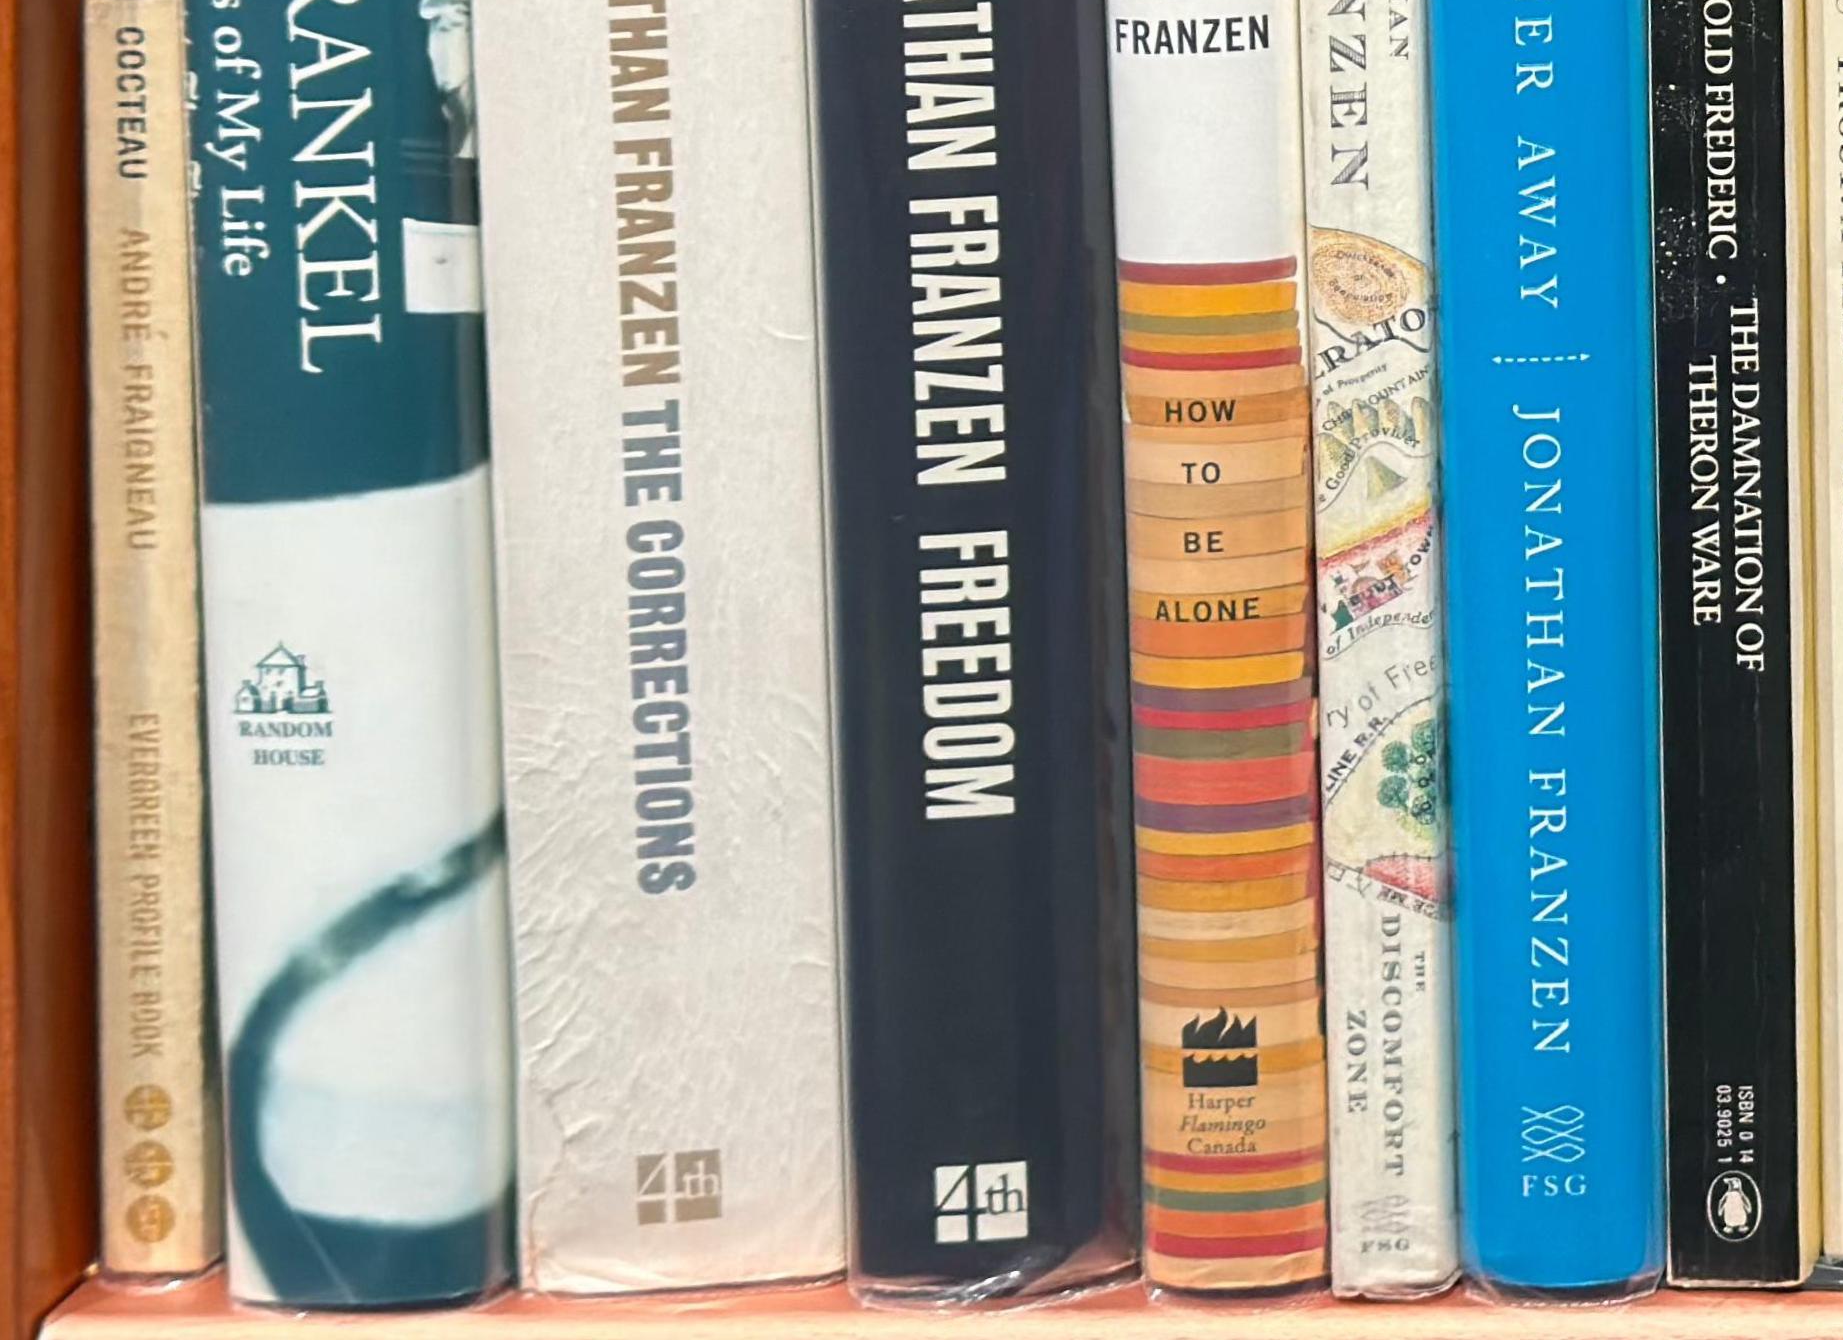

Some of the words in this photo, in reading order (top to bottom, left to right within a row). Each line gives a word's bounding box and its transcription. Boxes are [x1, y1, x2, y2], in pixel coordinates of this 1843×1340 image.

[210, 25, 261, 79] of
[1115, 14, 1269, 55] FRANZEN
[116, 26, 146, 181] COCTEAU
[205, 87, 262, 171] My
[1706, 82, 1738, 261] FREDERIC
[220, 185, 269, 276] Life
[613, 138, 681, 387] FRANZEN
[1517, 134, 1559, 310] AWAY
[119, 229, 167, 342] ANDRÉ
[909, 195, 1006, 484] FRANZEN
[1315, 308, 1426, 380] RATO
[1730, 297, 1759, 374] THE
[1164, 400, 1236, 423] HOW
[1688, 355, 1720, 512] THERON
[123, 362, 156, 551] FRAIGNEAU
[621, 400, 683, 507] THE
[1181, 462, 1221, 484] TO
[1731, 382, 1764, 615] DAMNATION
[1184, 531, 1224, 553] BE
[1512, 403, 1566, 737] JONATHAN
[1692, 519, 1722, 626] WARE
[1155, 597, 1261, 622] ALONE
[1736, 624, 1765, 672] OF
[625, 520, 696, 895] CORRECTIONS
[919, 530, 1015, 819] FREEDOM
[238, 720, 333, 738] RANDOM
[254, 749, 325, 766] HOUSE
[128, 714, 162, 860] EVERGREEN
[129, 873, 164, 976] PROFILE
[1529, 769, 1570, 1053] FRANZEN
[1416, 951, 1426, 992] THE
[130, 989, 164, 1058] BOOK
[1346, 1009, 1367, 1115] ZONE
[1380, 915, 1405, 1176] DISCOMFORT
[1178, 1114, 1266, 1134] Flamingo
[1188, 1092, 1255, 1113] Harper
[1738, 1085, 1754, 1123] ISBN
[1739, 1131, 1754, 1140] 0
[1187, 1136, 1257, 1155] Canada
[1523, 1175, 1587, 1197] FSG
[1739, 1149, 1754, 1163] 14
[637, 1149, 722, 1226] 4th
[934, 1161, 1028, 1243] 4th
